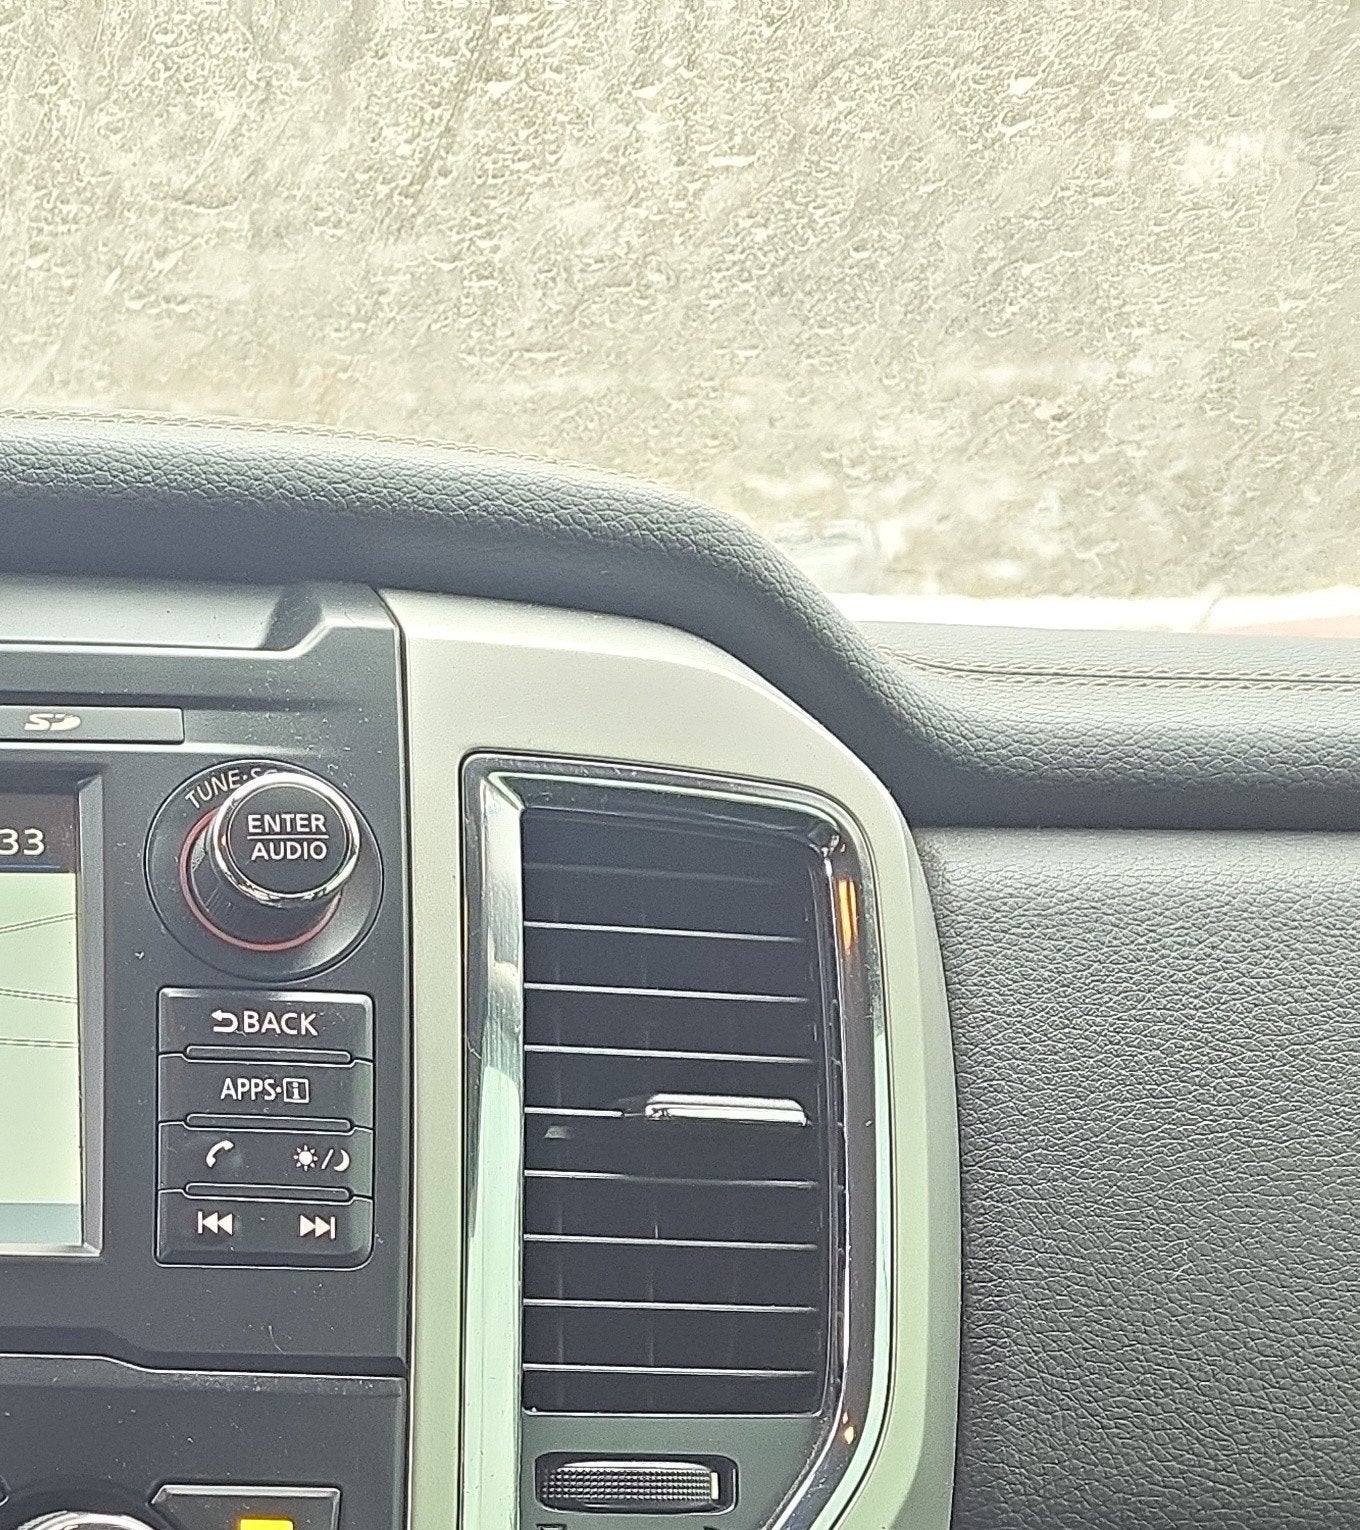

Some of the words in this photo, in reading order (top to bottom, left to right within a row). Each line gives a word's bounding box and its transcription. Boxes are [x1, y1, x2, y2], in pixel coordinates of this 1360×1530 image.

[24, 713, 81, 731] SD
[247, 813, 327, 834] ENTER
[251, 841, 328, 861] AUDIO
[243, 1010, 318, 1037] BACK
